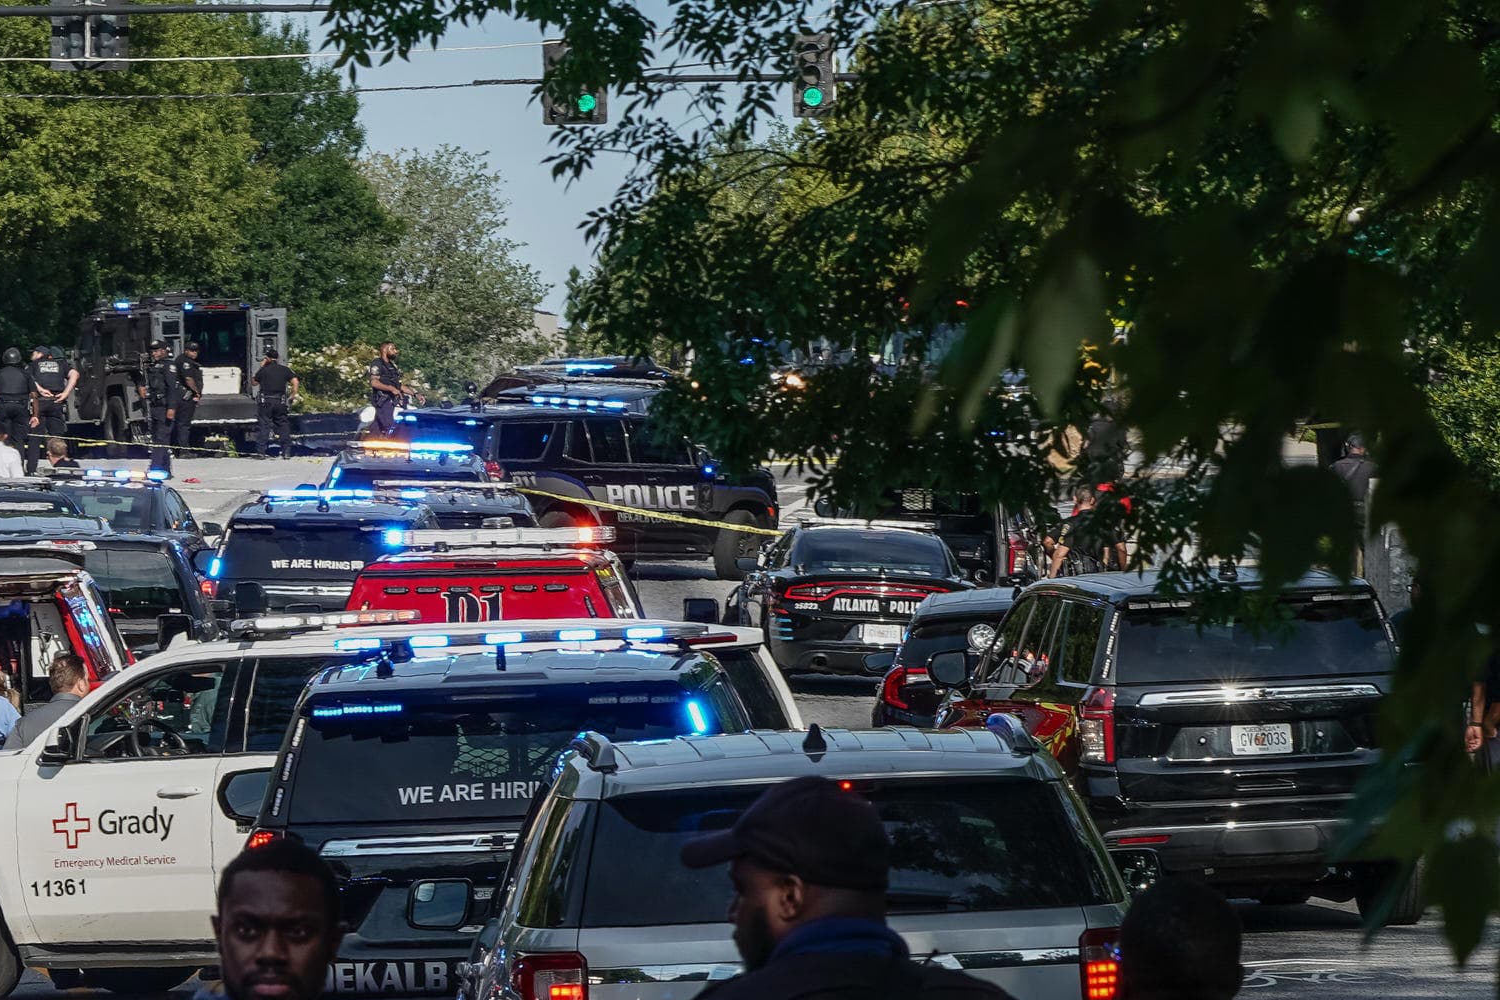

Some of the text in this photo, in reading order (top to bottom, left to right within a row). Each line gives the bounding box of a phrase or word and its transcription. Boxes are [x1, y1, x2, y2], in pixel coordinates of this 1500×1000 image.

[606, 484, 696, 510] POLICE
[271, 558, 351, 571] WE ARE HIRING
[440, 592, 503, 623] D1
[832, 597, 880, 612] ATLANTA
[398, 786, 434, 805] WE
[438, 783, 484, 802] ARE
[98, 806, 174, 841] Grady
[54, 855, 176, 869] Emergency Medical Service
[31, 879, 86, 897] 11361
